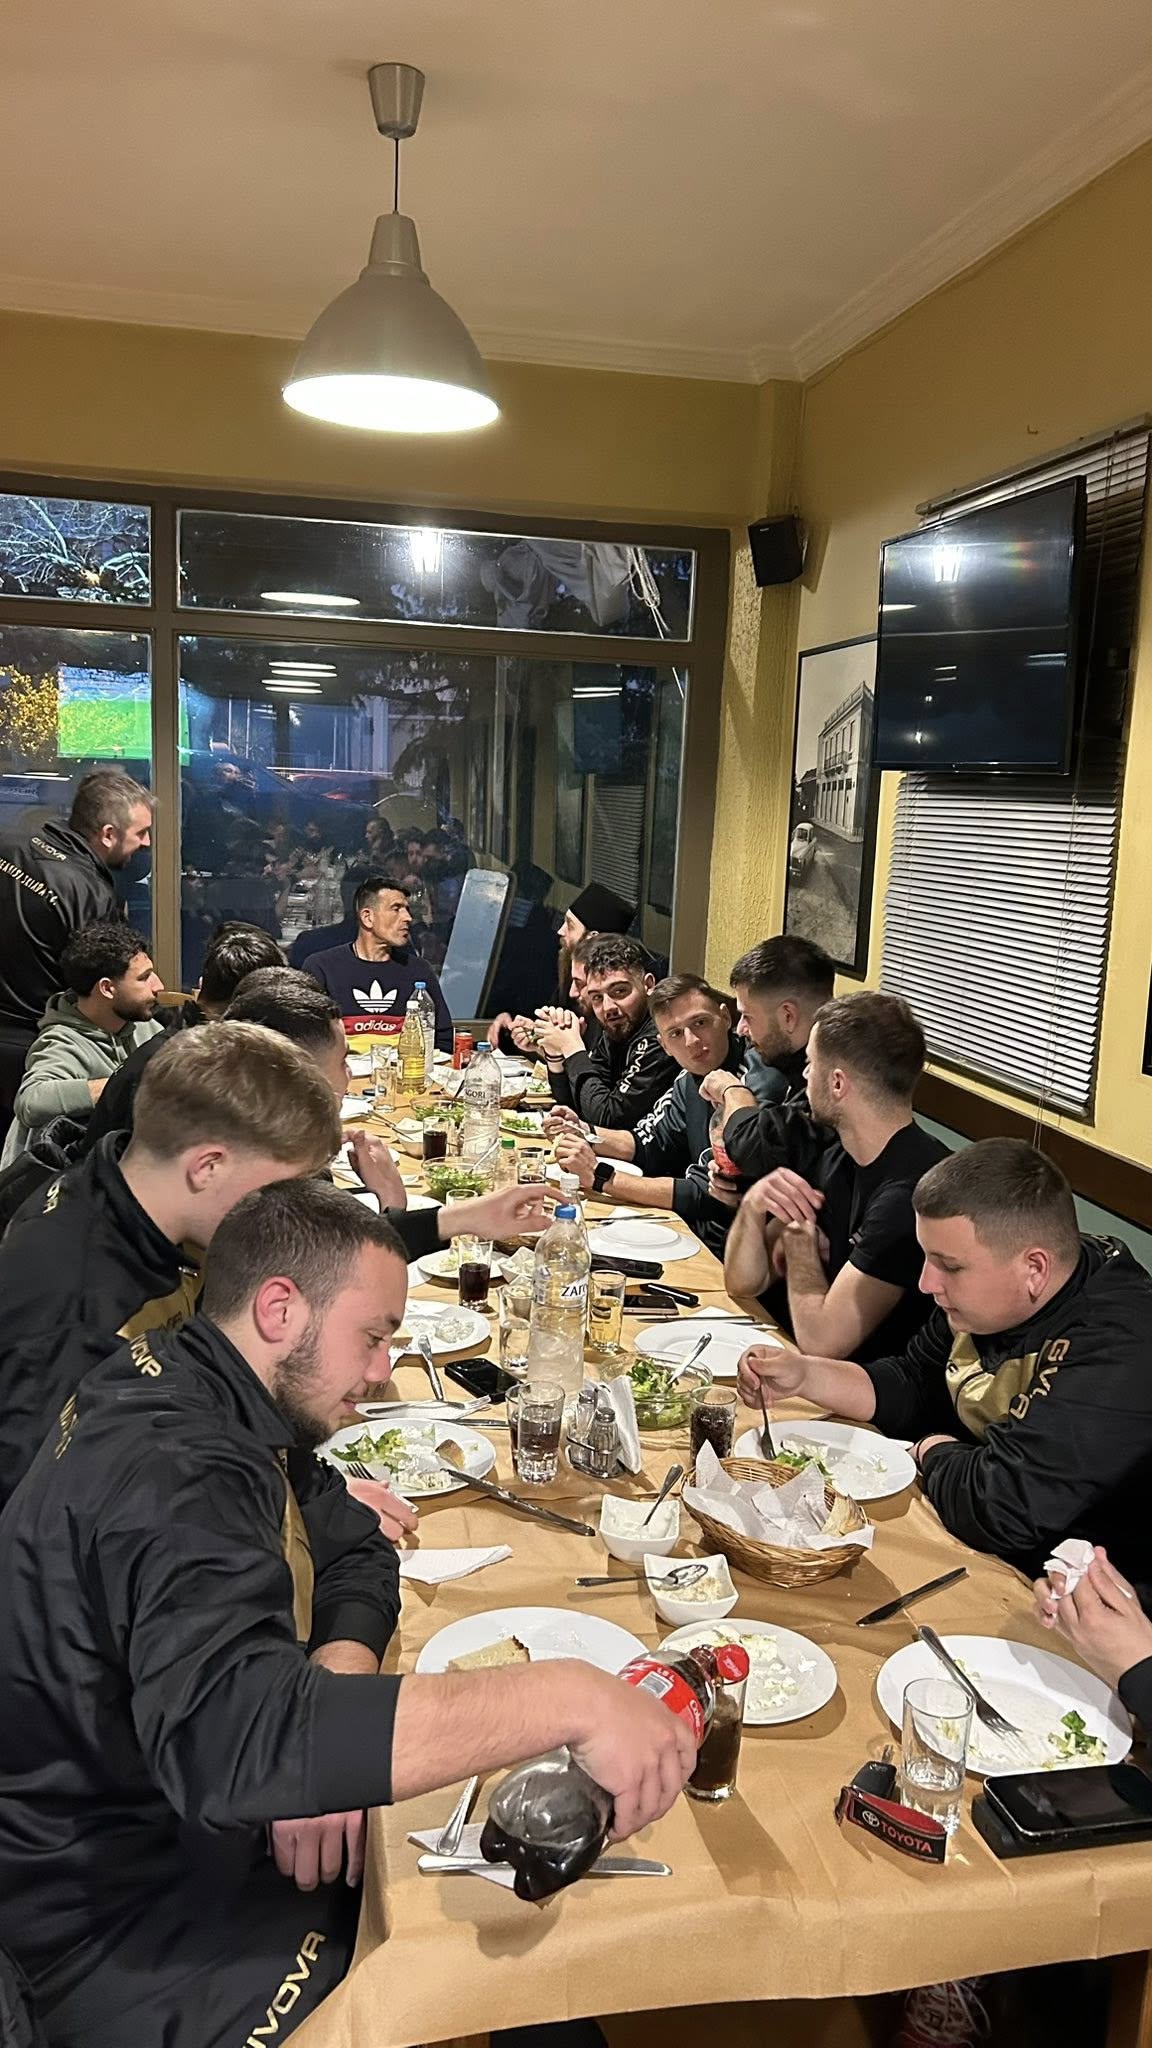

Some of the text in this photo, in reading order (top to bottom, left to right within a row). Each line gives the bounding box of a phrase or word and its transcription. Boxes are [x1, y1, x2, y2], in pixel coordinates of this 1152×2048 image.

[32, 837, 67, 860] GIVOVA
[354, 1020, 397, 1031] adidas
[881, 1822, 932, 1853] TOYOTA
[242, 1931, 326, 2048] IVOVA
